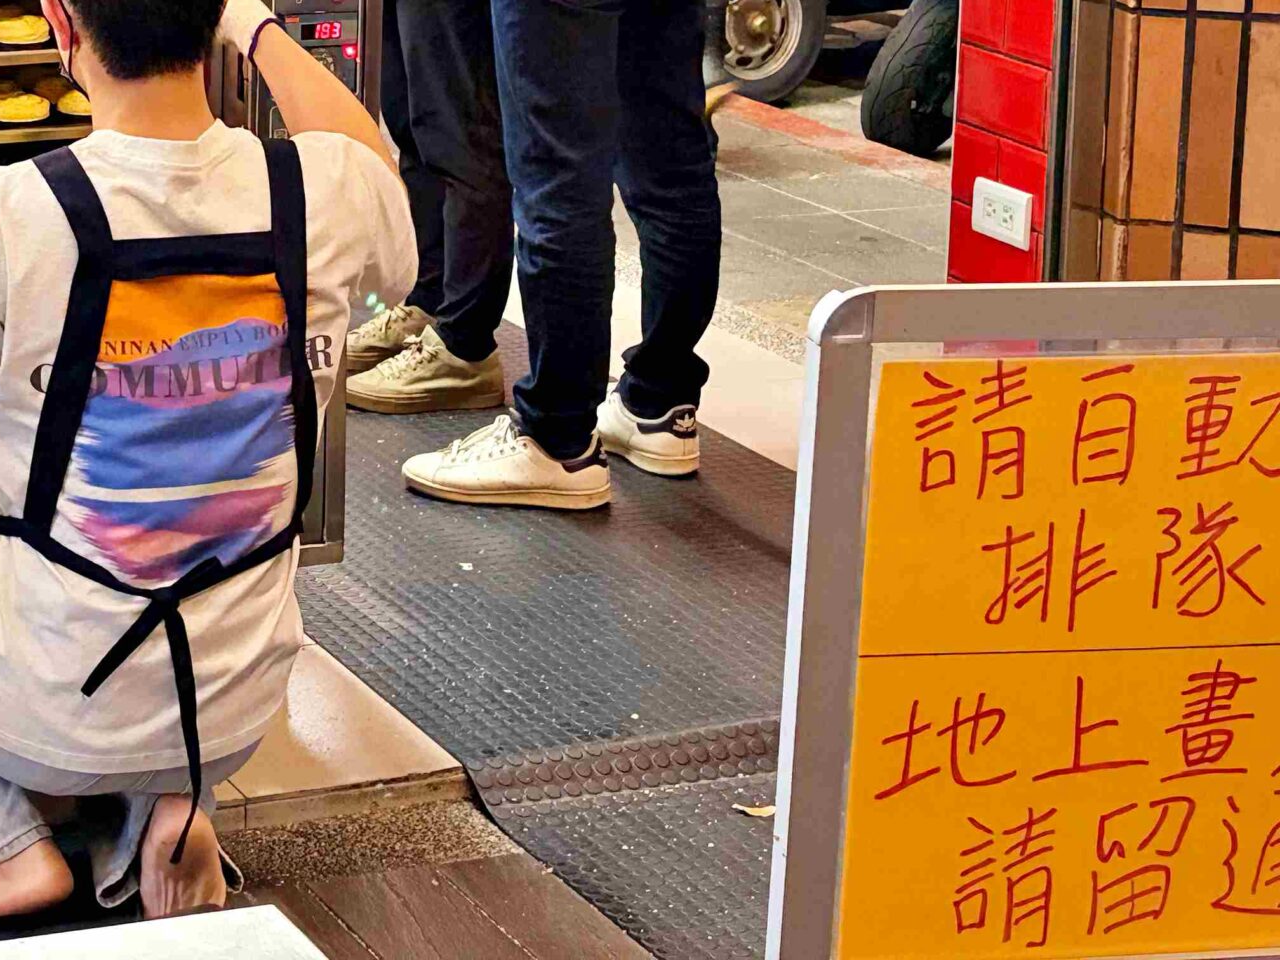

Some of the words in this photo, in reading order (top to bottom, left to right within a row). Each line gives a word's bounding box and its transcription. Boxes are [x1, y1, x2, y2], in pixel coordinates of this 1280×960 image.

[911, 359, 1280, 500] 請自動
[981, 501, 1266, 632] 排隊
[873, 658, 1280, 801] 地上畫
